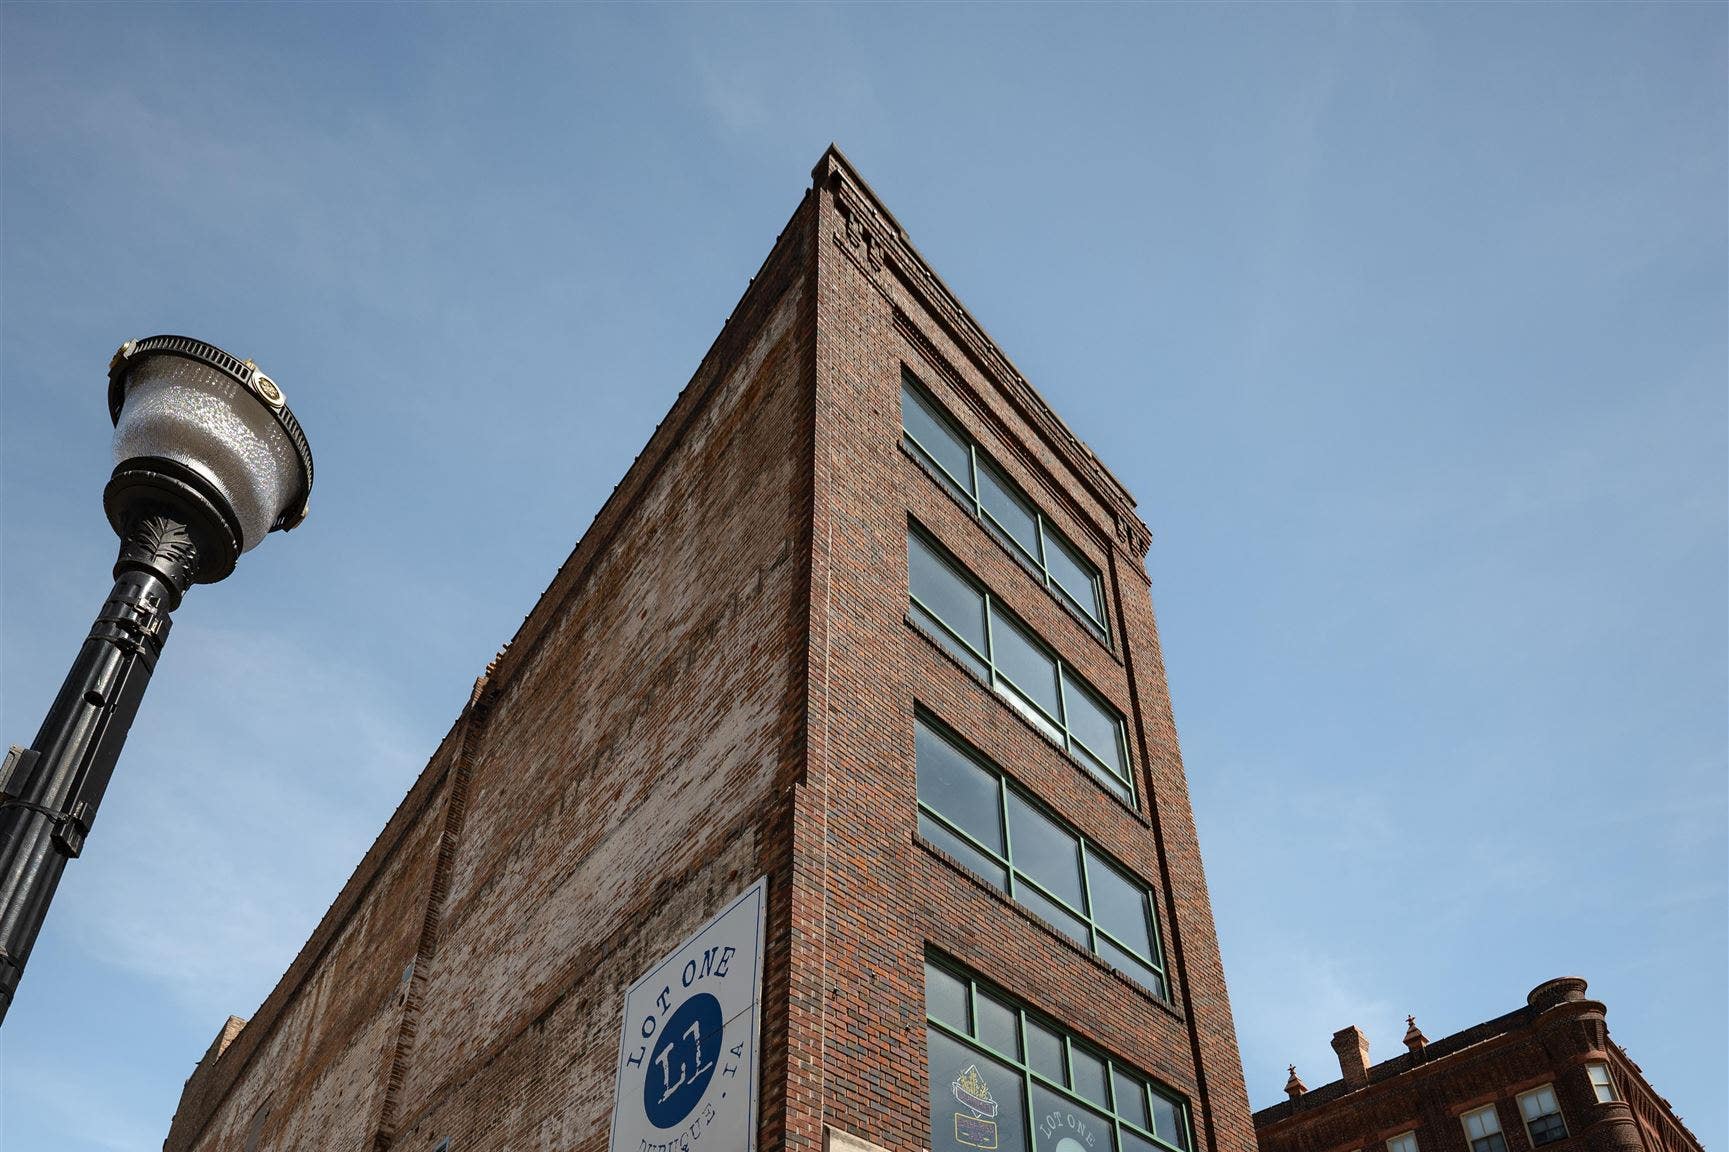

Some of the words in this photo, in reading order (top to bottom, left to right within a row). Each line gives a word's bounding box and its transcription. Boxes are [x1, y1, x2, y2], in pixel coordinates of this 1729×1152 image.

[627, 986, 672, 1069] LOT
[682, 946, 736, 988] ONE
[723, 1040, 744, 1080] IA
[1040, 1111, 1063, 1139] LOT
[1067, 1114, 1096, 1147] ONE
